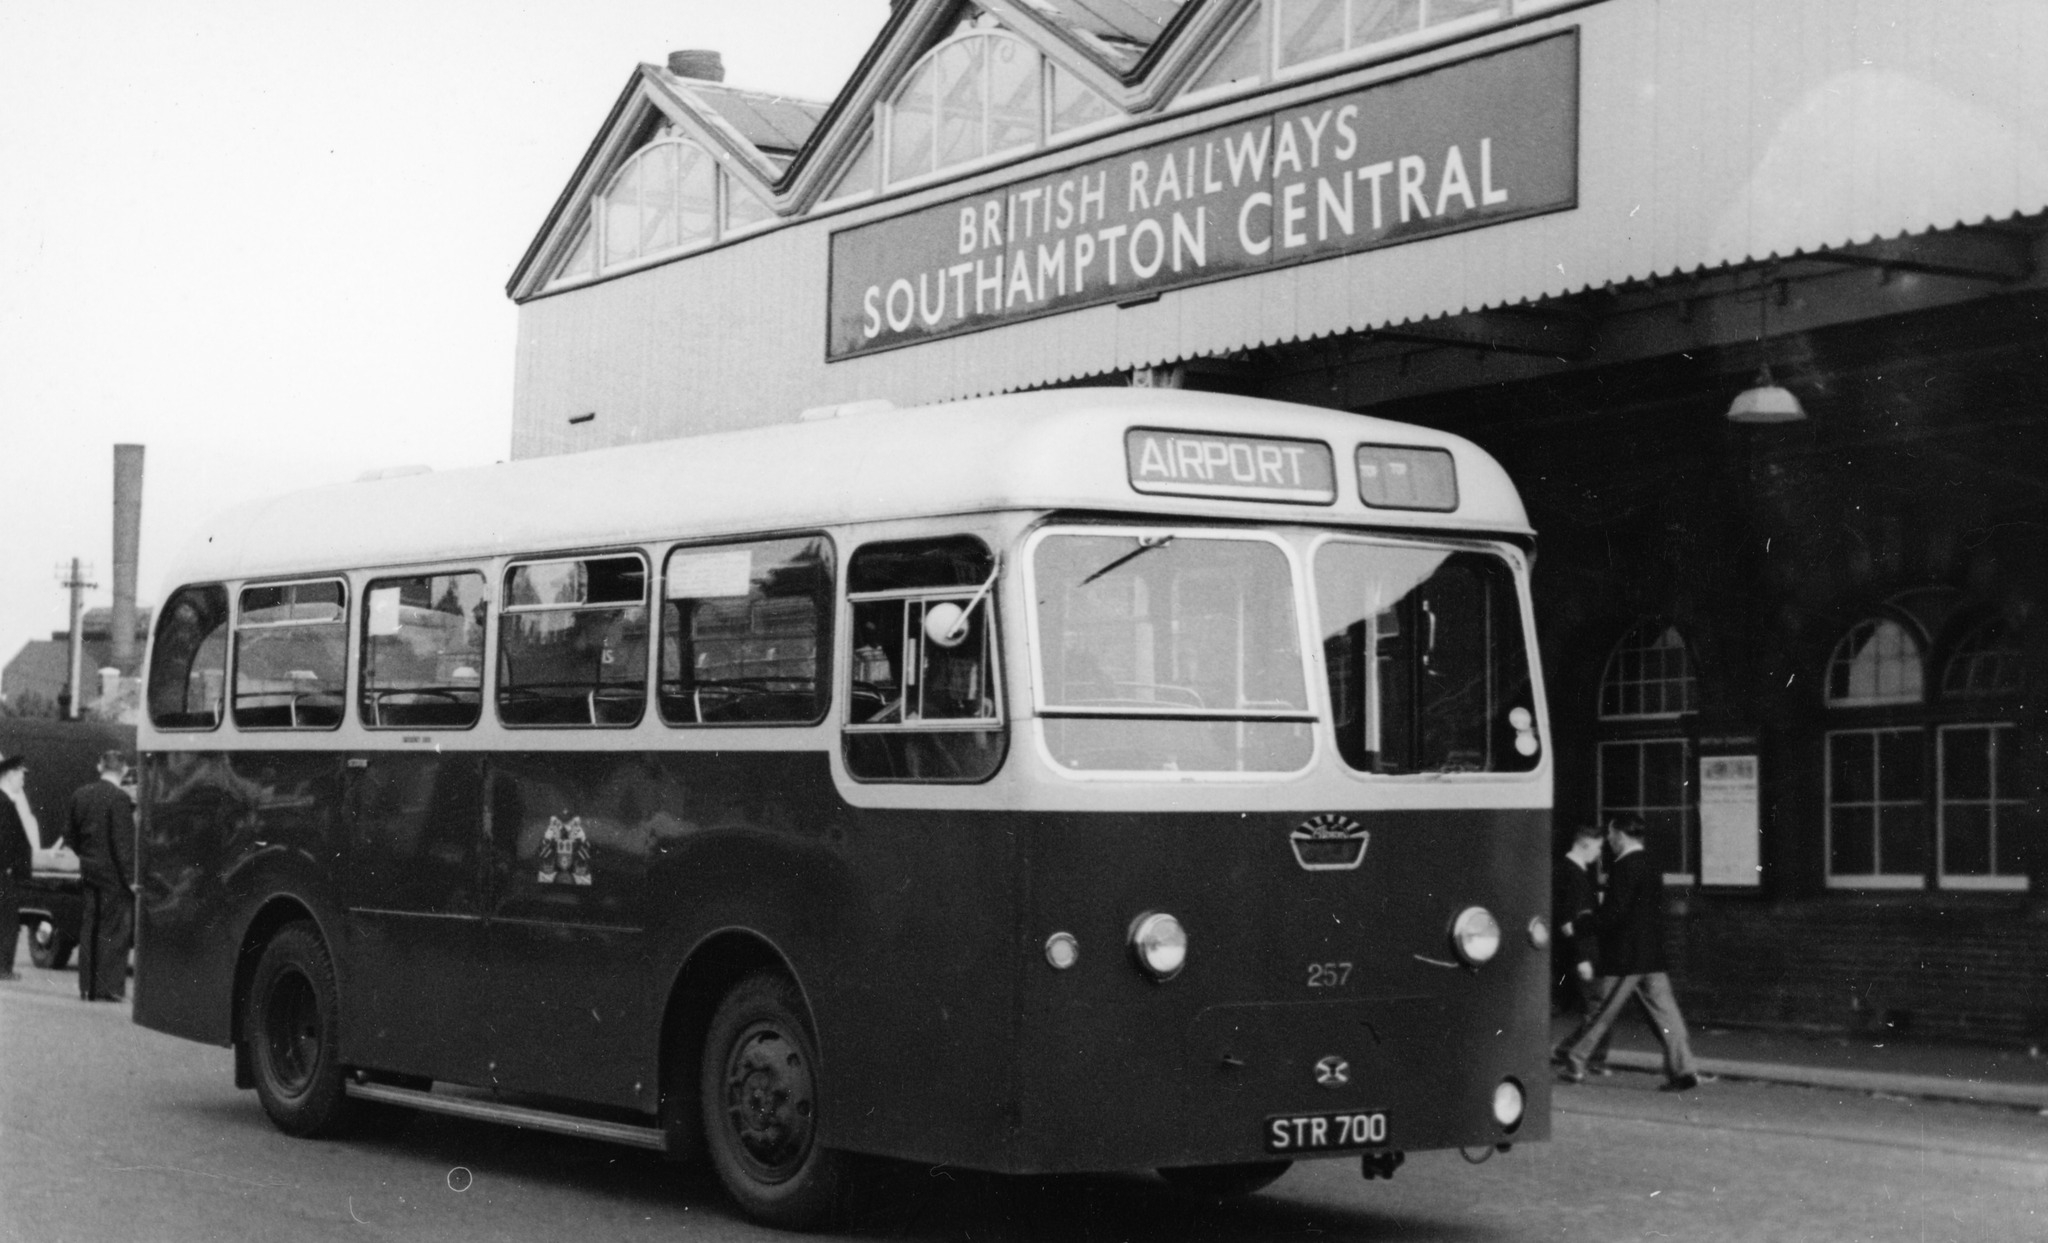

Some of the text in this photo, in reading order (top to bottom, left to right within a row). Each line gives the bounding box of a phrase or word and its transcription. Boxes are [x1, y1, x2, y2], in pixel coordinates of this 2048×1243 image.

[959, 104, 1359, 255] BRITISH RAILWAYS
[863, 137, 1508, 339] SOUTHAMPTON CENTRAL
[1140, 437, 1305, 485] AIRPORT
[1307, 962, 1353, 987] 257
[1272, 1113, 1386, 1148] STR 700
